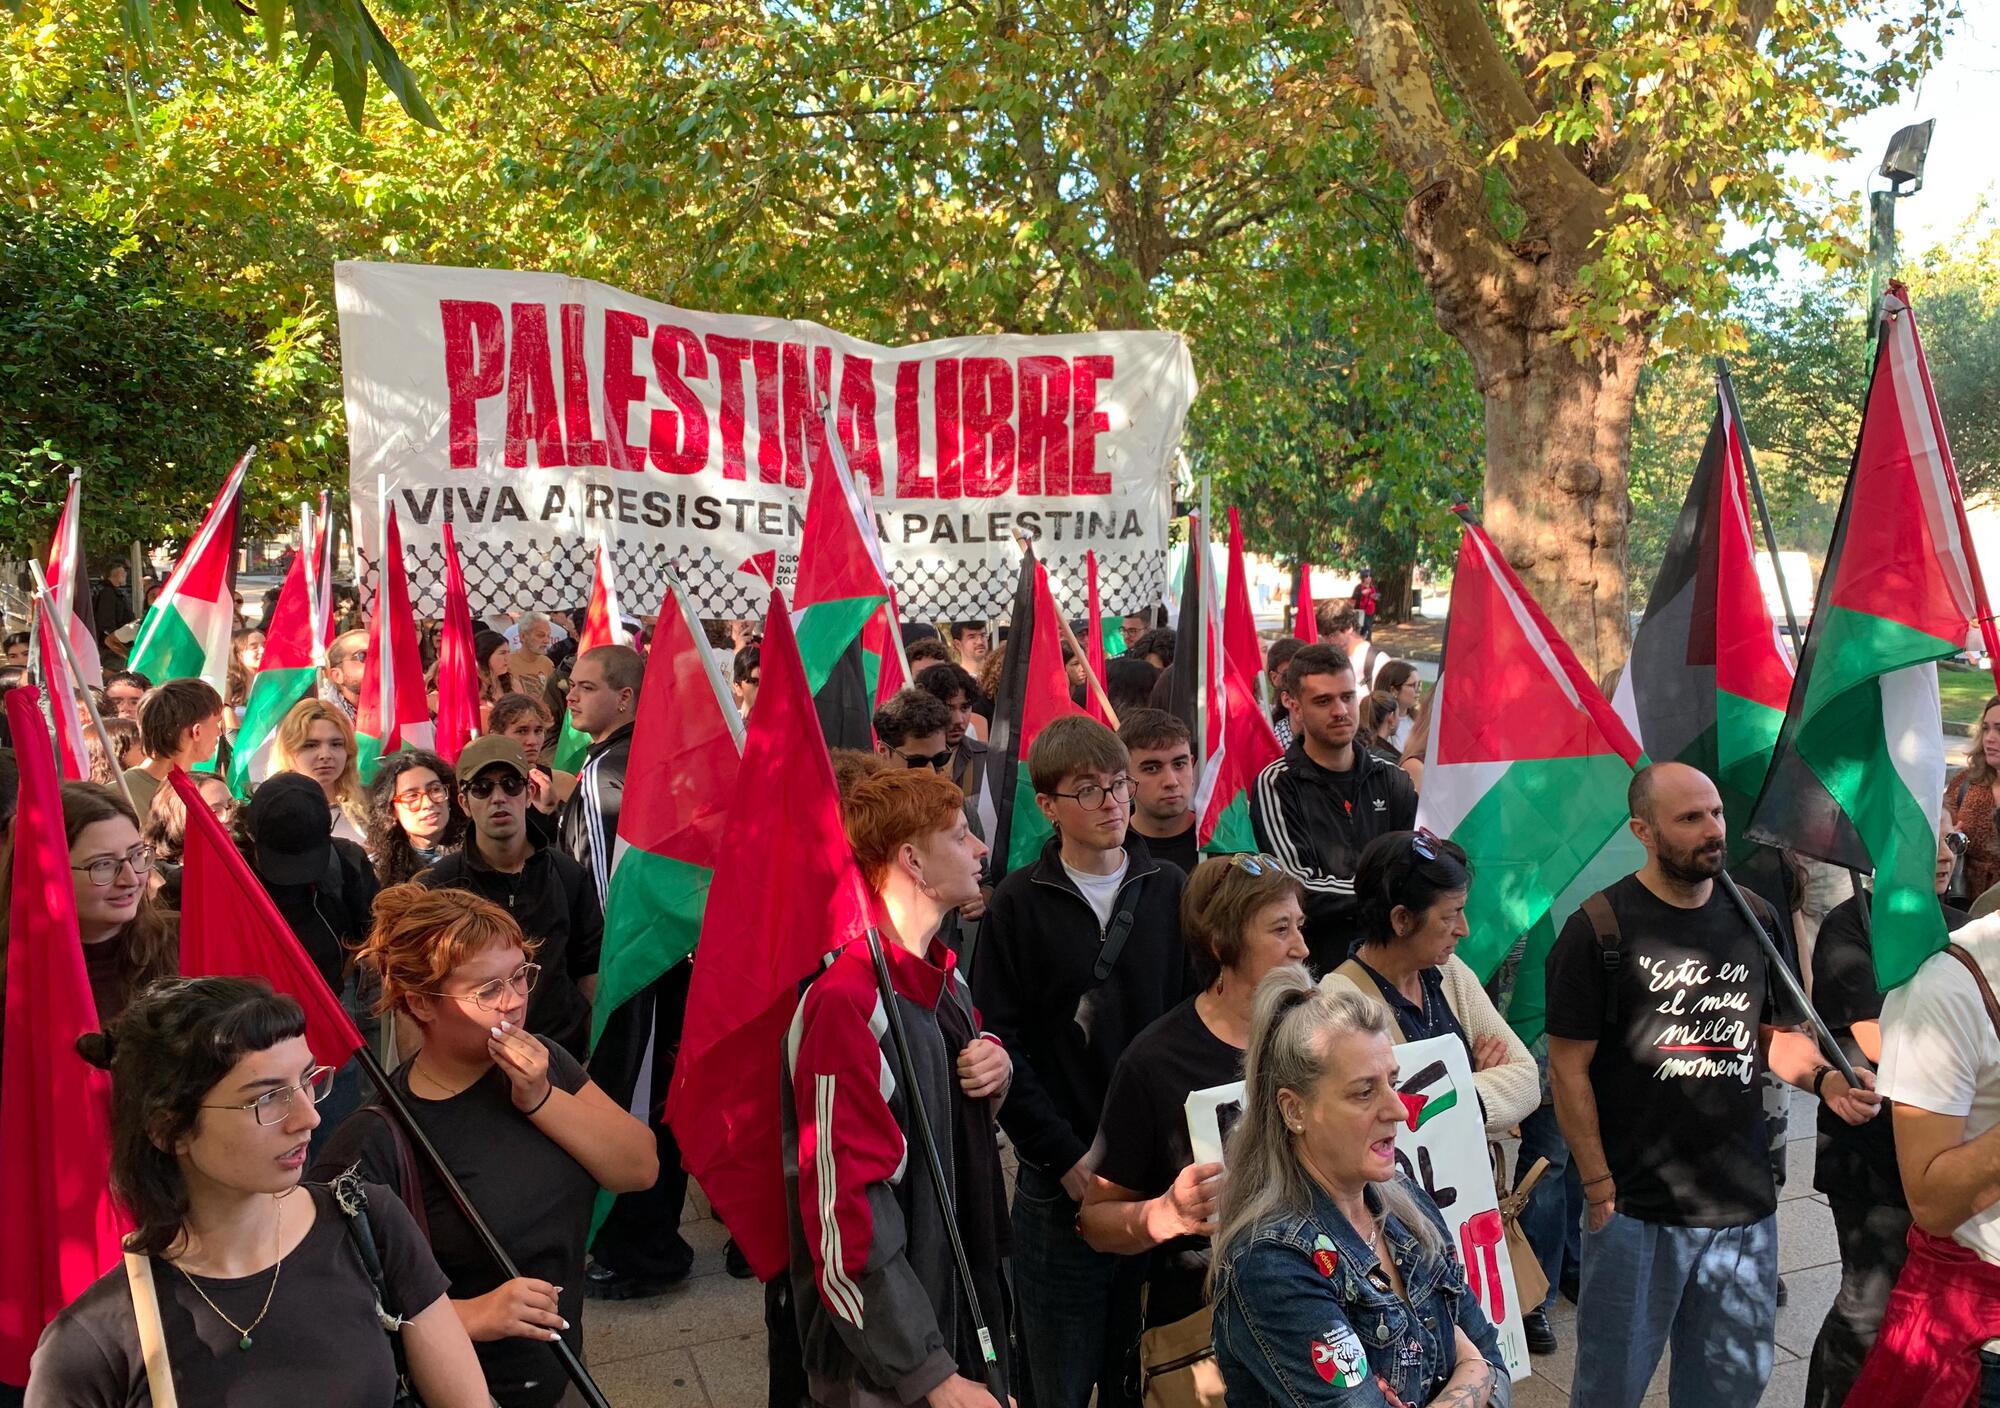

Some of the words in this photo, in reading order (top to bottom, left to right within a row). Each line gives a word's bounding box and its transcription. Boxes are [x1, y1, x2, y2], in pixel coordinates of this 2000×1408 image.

[439, 299, 885, 497] PALESTINA
[895, 355, 1114, 500] LIBRE
[401, 485, 529, 525] VIVA
[539, 485, 576, 521] A
[585, 484, 891, 544] RESISTEN
[903, 508, 1144, 544] PALESTINA
[1716, 962, 1749, 983] en
[1656, 988, 1686, 1015] el
[1690, 992, 1750, 1014] meu
[1653, 1016, 1750, 1050] millor
[1318, 1249, 1335, 1275] happy
